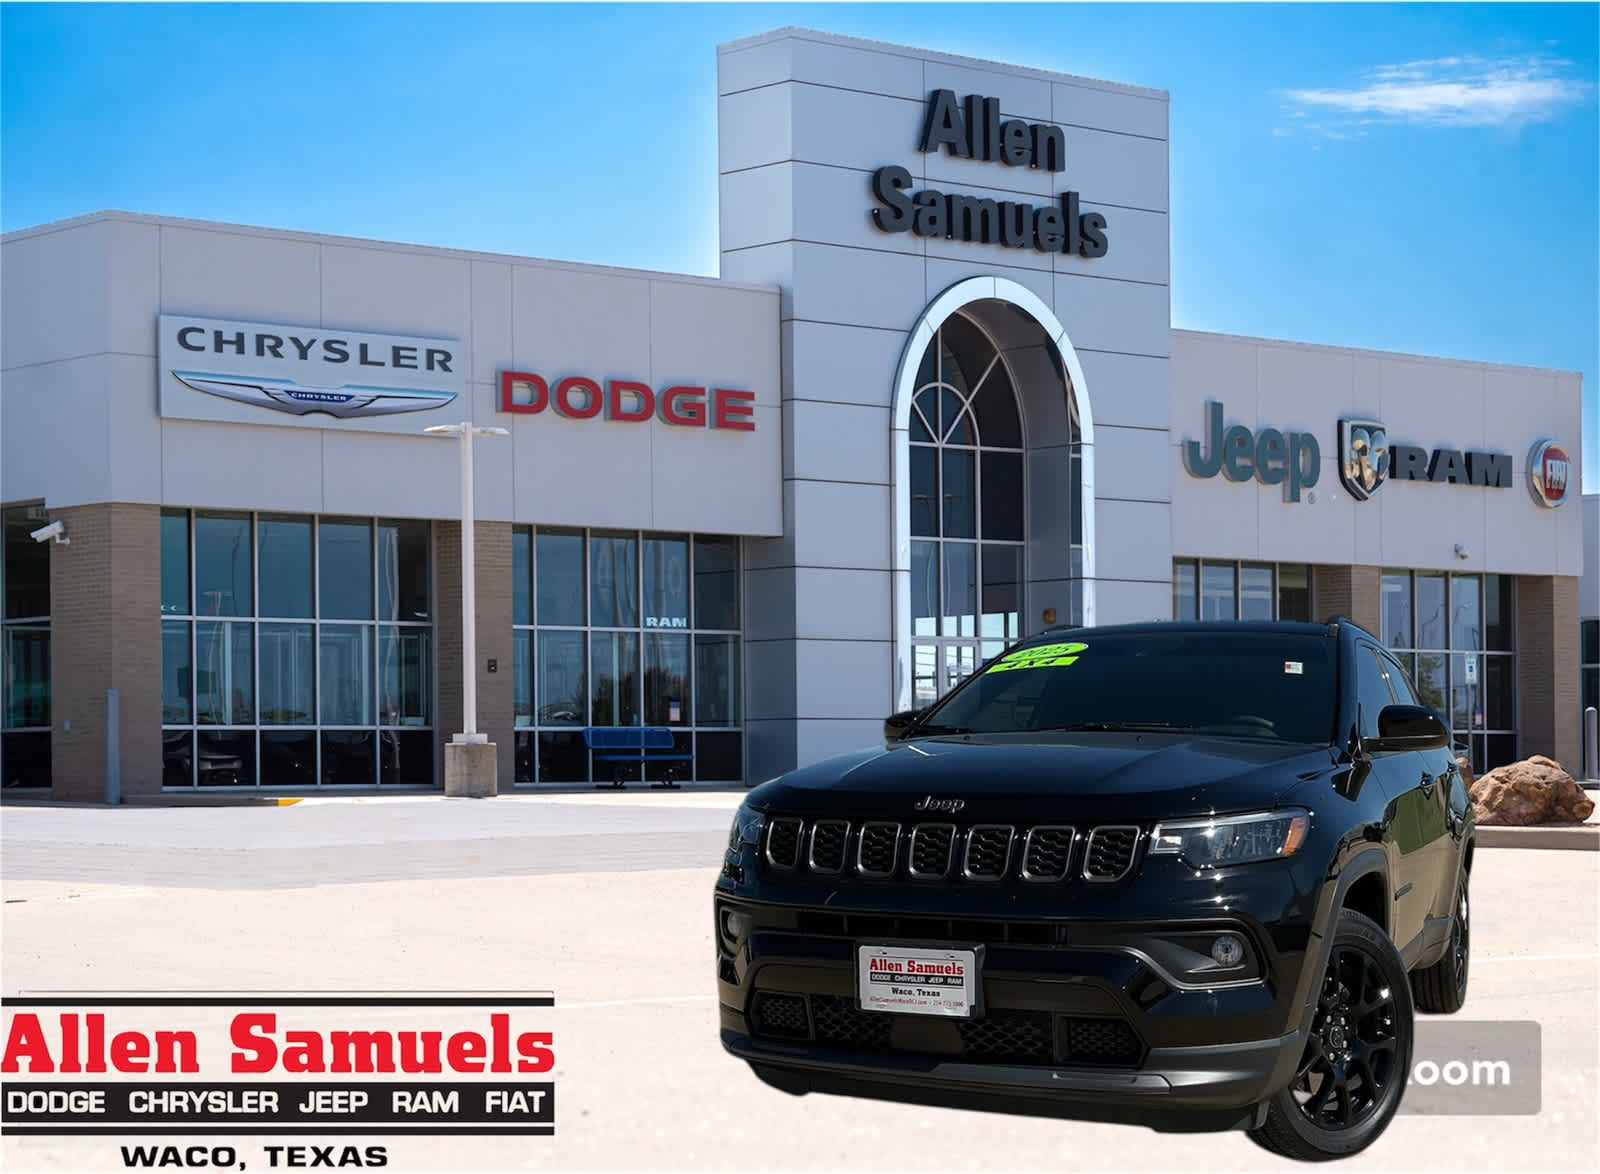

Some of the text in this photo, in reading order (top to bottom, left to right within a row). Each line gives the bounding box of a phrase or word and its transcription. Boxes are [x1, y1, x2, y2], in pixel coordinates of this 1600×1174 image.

[919, 89, 1066, 172] Allen
[872, 165, 1109, 258] Samuels
[176, 326, 454, 373] CHRYSLER
[291, 392, 347, 401] CHRYSLER
[495, 370, 756, 432] DODGE
[1182, 401, 1321, 503] Jeep
[1388, 445, 1513, 488] RAM
[1546, 459, 1568, 489] FIAT
[646, 616, 687, 628] RAM
[914, 795, 966, 814] Jeep
[870, 958, 964, 975] Allen Samuels
[871, 973, 963, 985] DODGE CHRYSLER JEEP RAM
[891, 987, 941, 997] Waco, Texas
